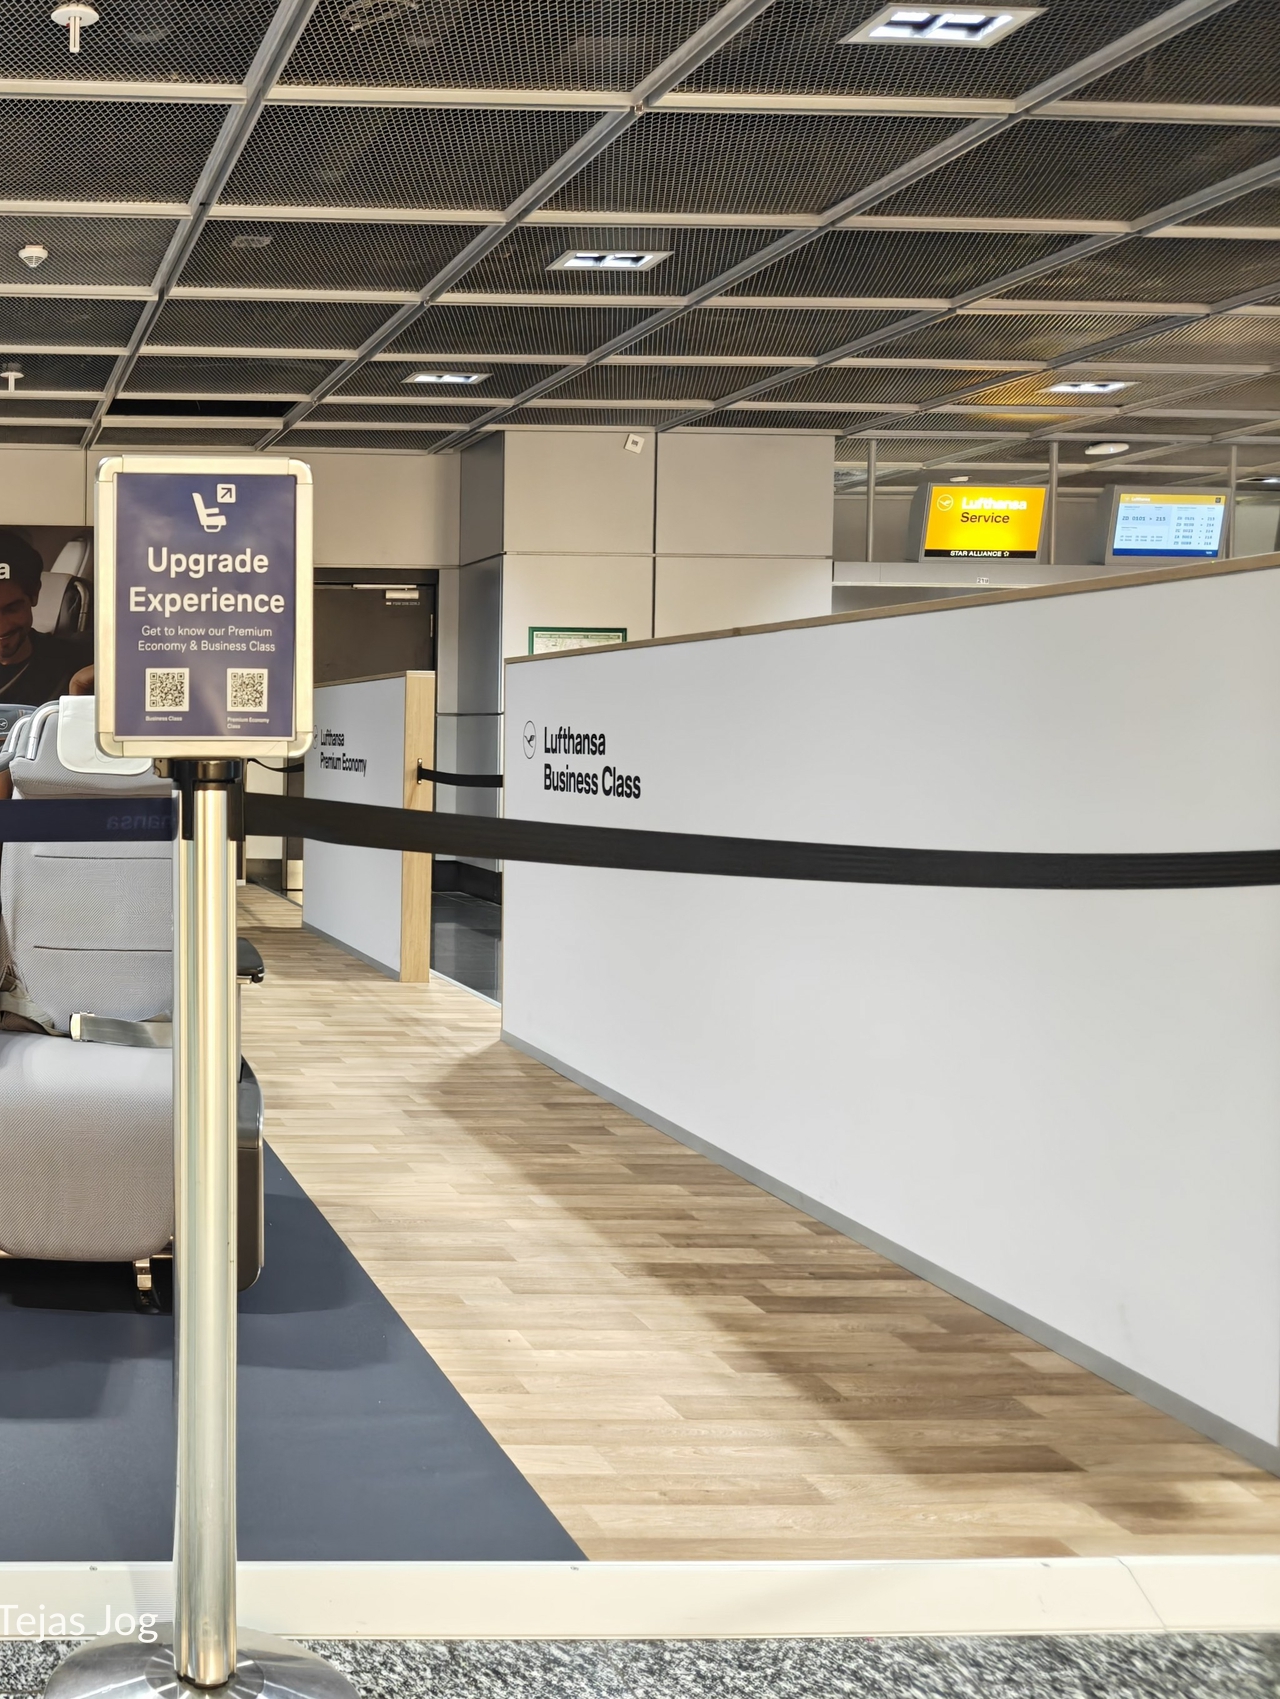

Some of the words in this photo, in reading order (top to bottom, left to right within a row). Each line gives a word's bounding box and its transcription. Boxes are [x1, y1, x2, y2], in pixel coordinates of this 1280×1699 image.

[961, 496, 1028, 511] Lufthansa
[960, 511, 1010, 524] Service
[147, 546, 269, 579] Upgrade
[129, 586, 285, 618] Experience
[141, 625, 161, 636] Get
[164, 626, 175, 636] to
[178, 625, 205, 636] know
[208, 627, 225, 636] our
[228, 625, 273, 637] Premium
[138, 640, 187, 653] Economy
[189, 640, 198, 651] &
[201, 640, 246, 652] Business
[249, 641, 276, 652] Class
[320, 729, 345, 747] Lufthansa
[543, 725, 607, 756] Lufthansa
[320, 751, 342, 771] Premium
[342, 752, 368, 777] Economy
[543, 763, 599, 796] Business
[601, 765, 641, 799] Class
